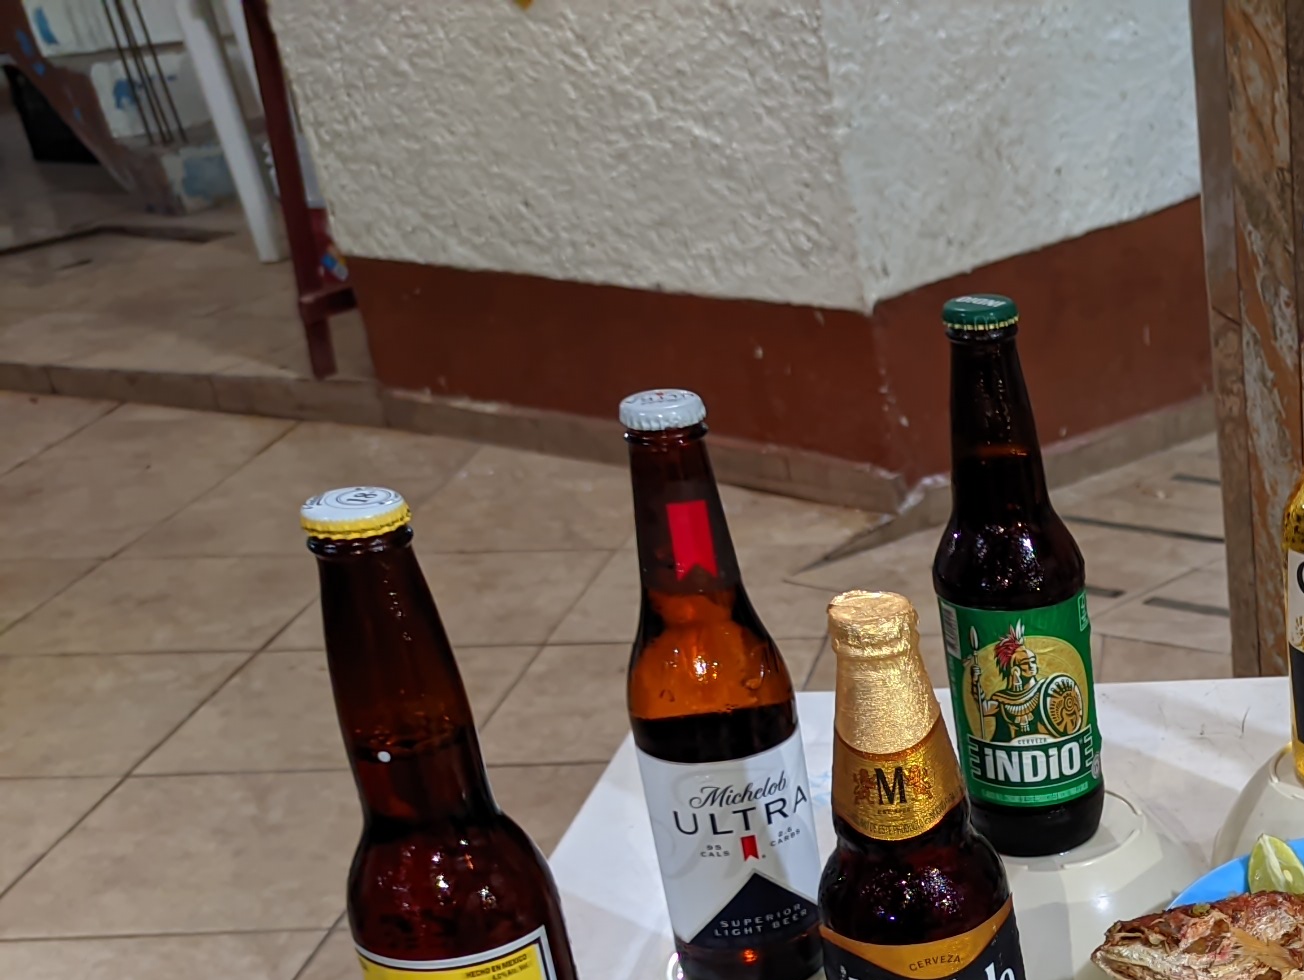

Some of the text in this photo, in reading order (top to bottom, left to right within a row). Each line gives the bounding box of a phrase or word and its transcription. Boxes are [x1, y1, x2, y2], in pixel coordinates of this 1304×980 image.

[689, 770, 787, 809] Michelob
[874, 766, 907, 805] M
[673, 785, 807, 836] ULTRA
[700, 850, 730, 858] CALS
[713, 908, 808, 937] LIGHT BEER
[719, 903, 801, 928] SUPERIOR
[909, 954, 961, 971] CERVEZA
